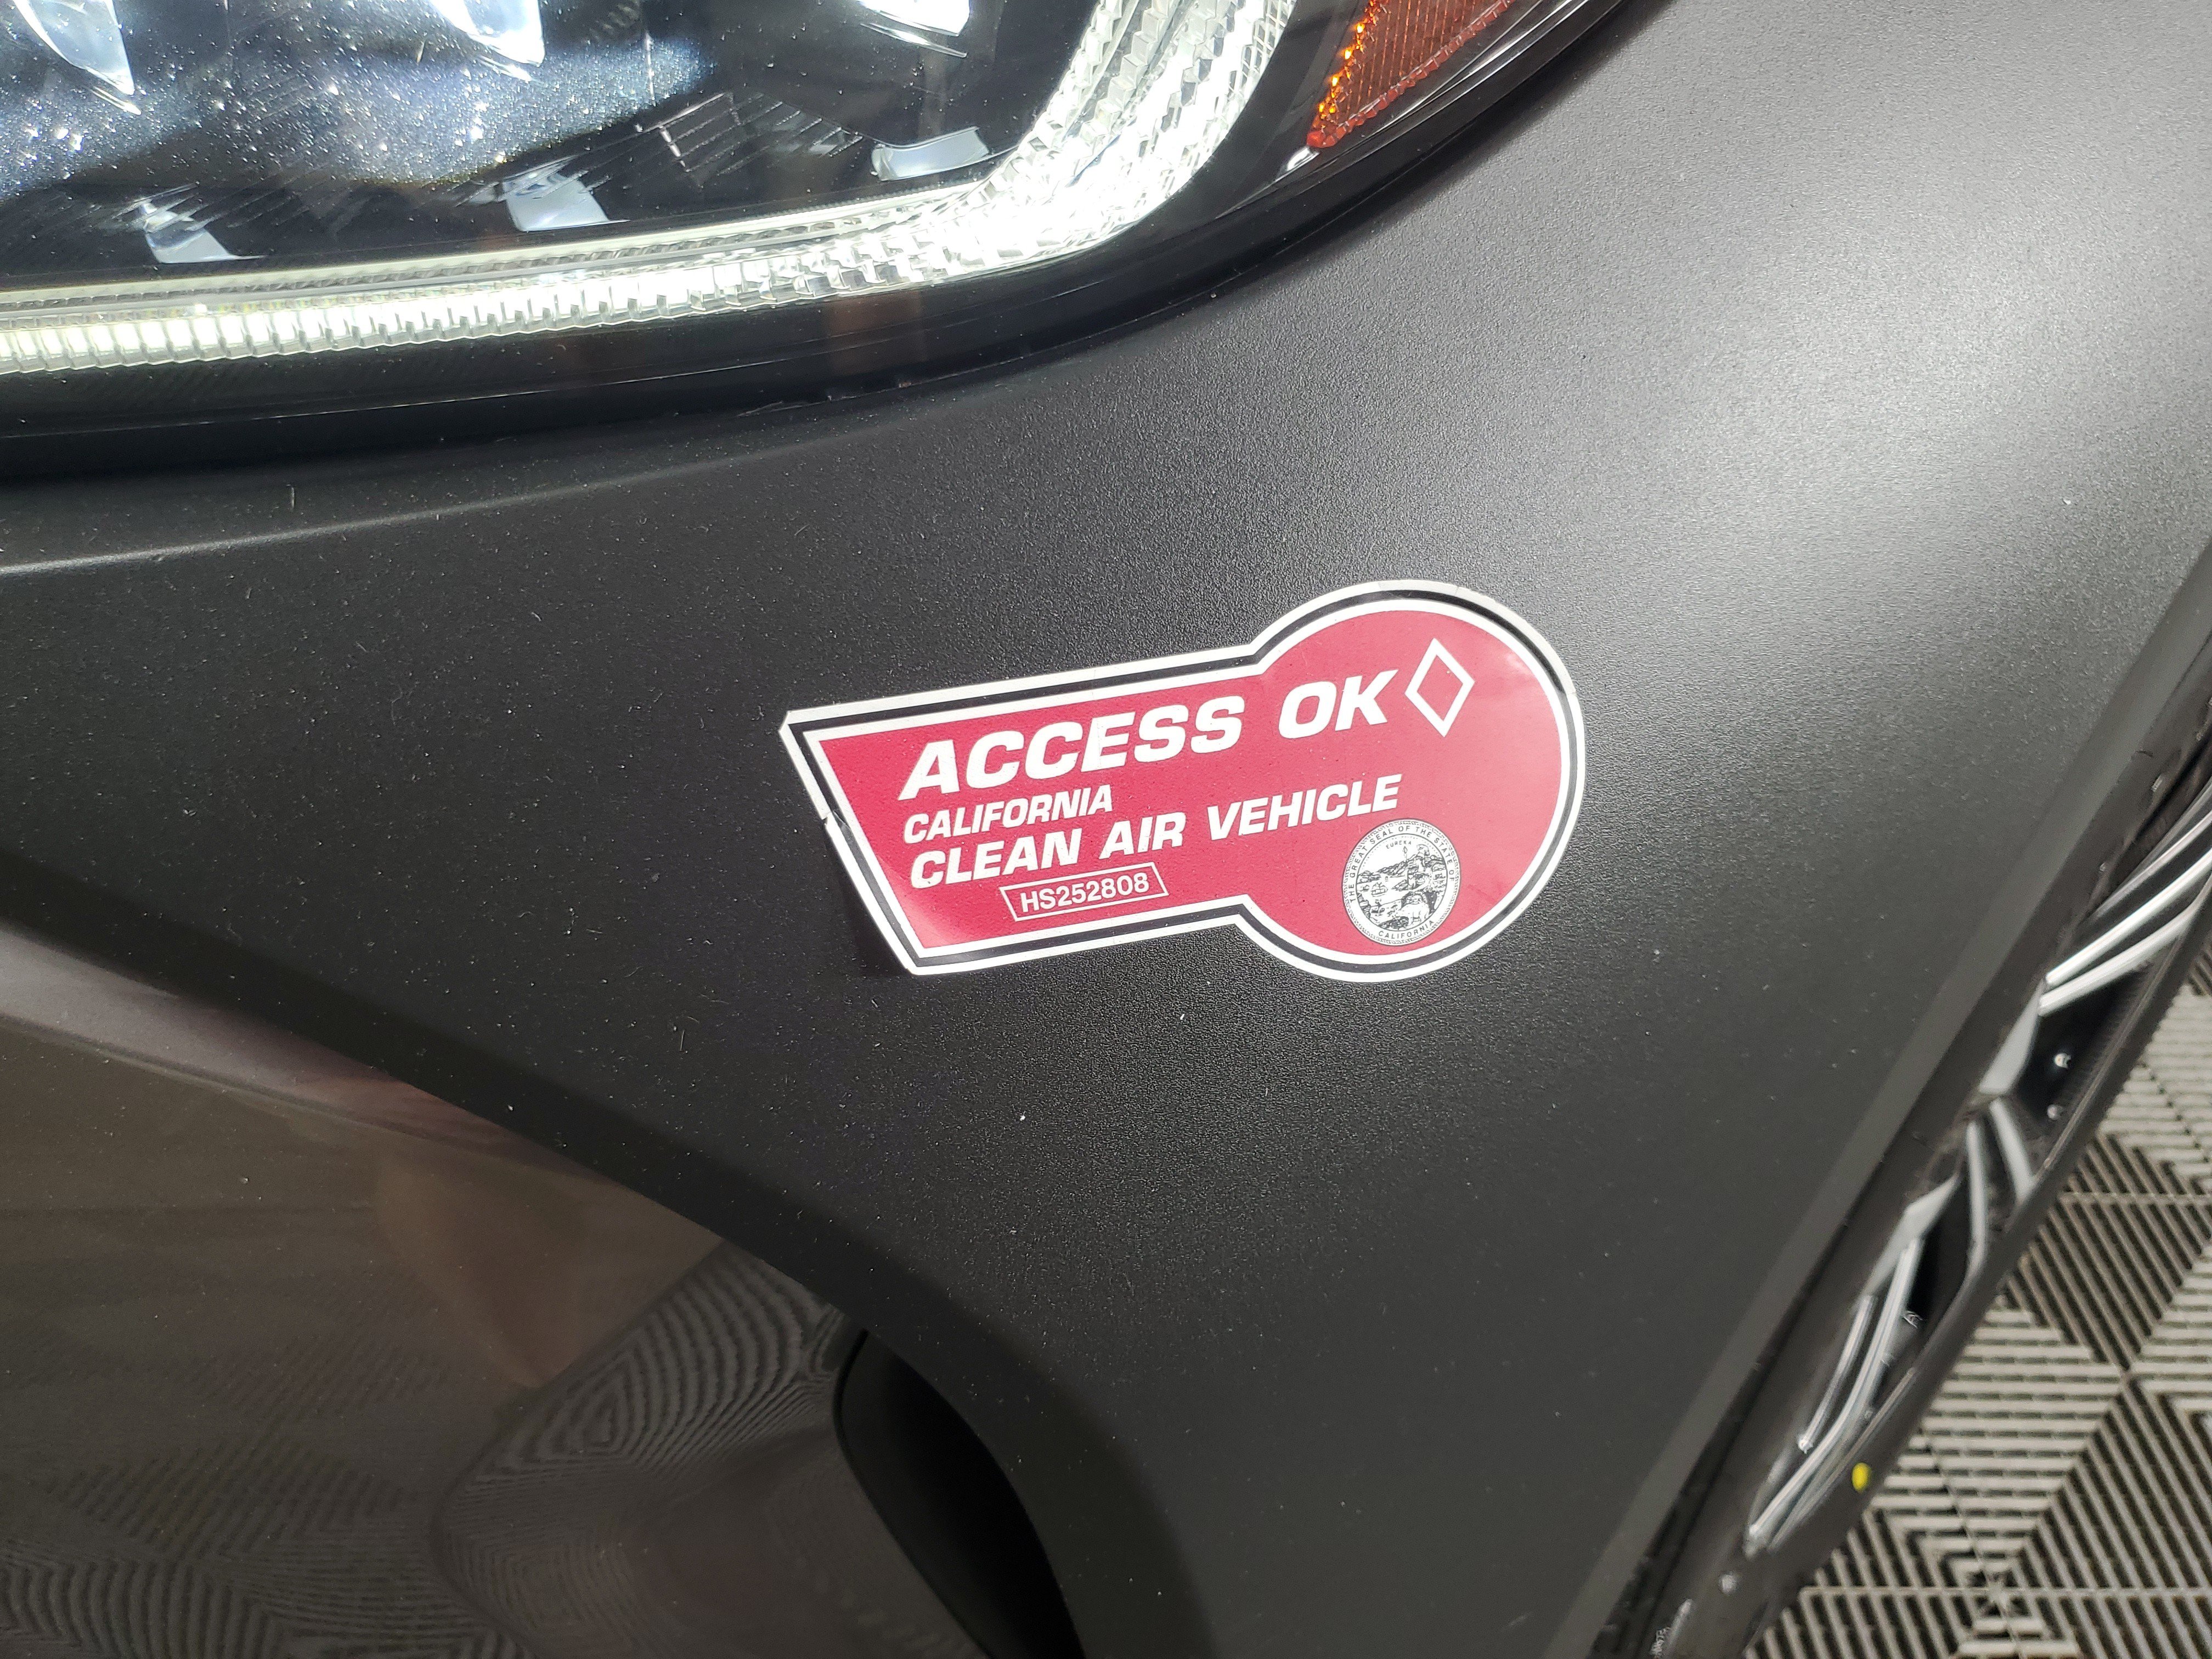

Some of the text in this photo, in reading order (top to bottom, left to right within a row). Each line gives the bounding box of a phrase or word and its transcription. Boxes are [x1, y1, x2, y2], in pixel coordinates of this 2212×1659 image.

[897, 668, 1400, 801] ACCESS OK
[903, 784, 1113, 844] CALIFORNIA
[910, 773, 1403, 889] CLEAN AIR VEHICLE
[1370, 828, 1395, 845] SEAL
[1415, 827, 1431, 838] THE
[1386, 840, 1412, 849] EUREKA
[1434, 837, 1453, 865] STATE
[1351, 846, 1368, 878] GREAT
[1449, 870, 1455, 882] OF
[1020, 872, 1149, 913] HS252808
[1347, 884, 1356, 903] THE
[1378, 920, 1435, 939] CALIFORNIA
